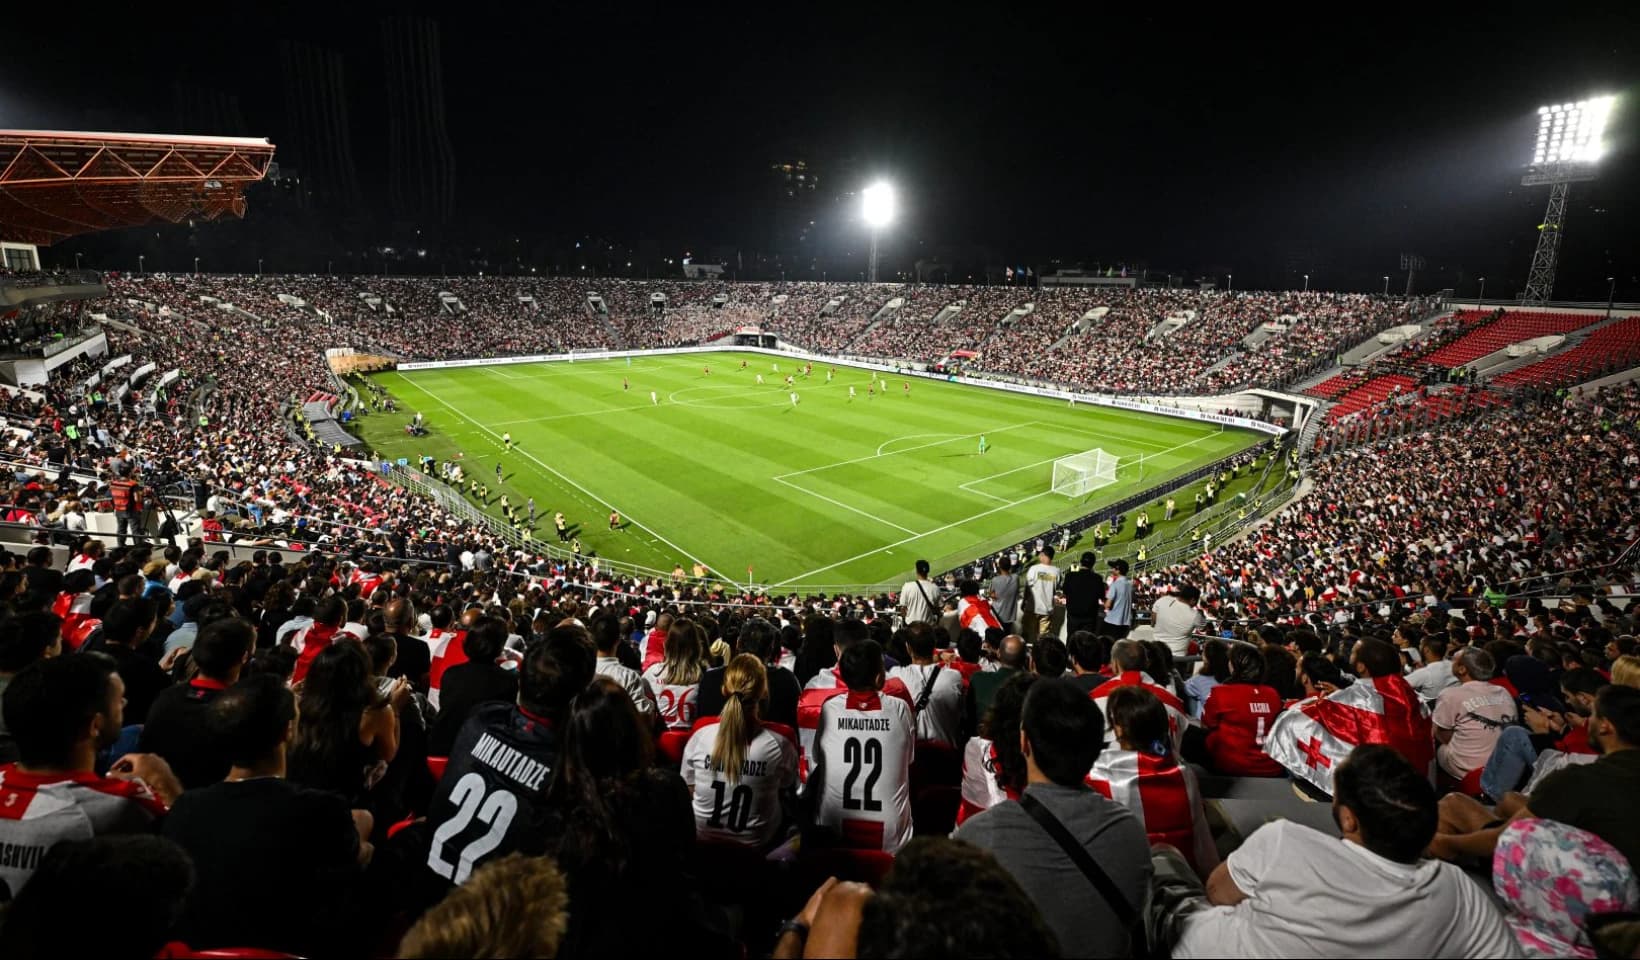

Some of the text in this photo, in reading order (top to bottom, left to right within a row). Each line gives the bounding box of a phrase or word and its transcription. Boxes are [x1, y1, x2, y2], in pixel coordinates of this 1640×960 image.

[659, 688, 697, 723] 26
[838, 718, 891, 731] MIKAUTADZE
[471, 732, 550, 791] MIKAUTADZE
[843, 737, 882, 812] 22
[427, 772, 518, 886] 22
[706, 780, 753, 832] 10
